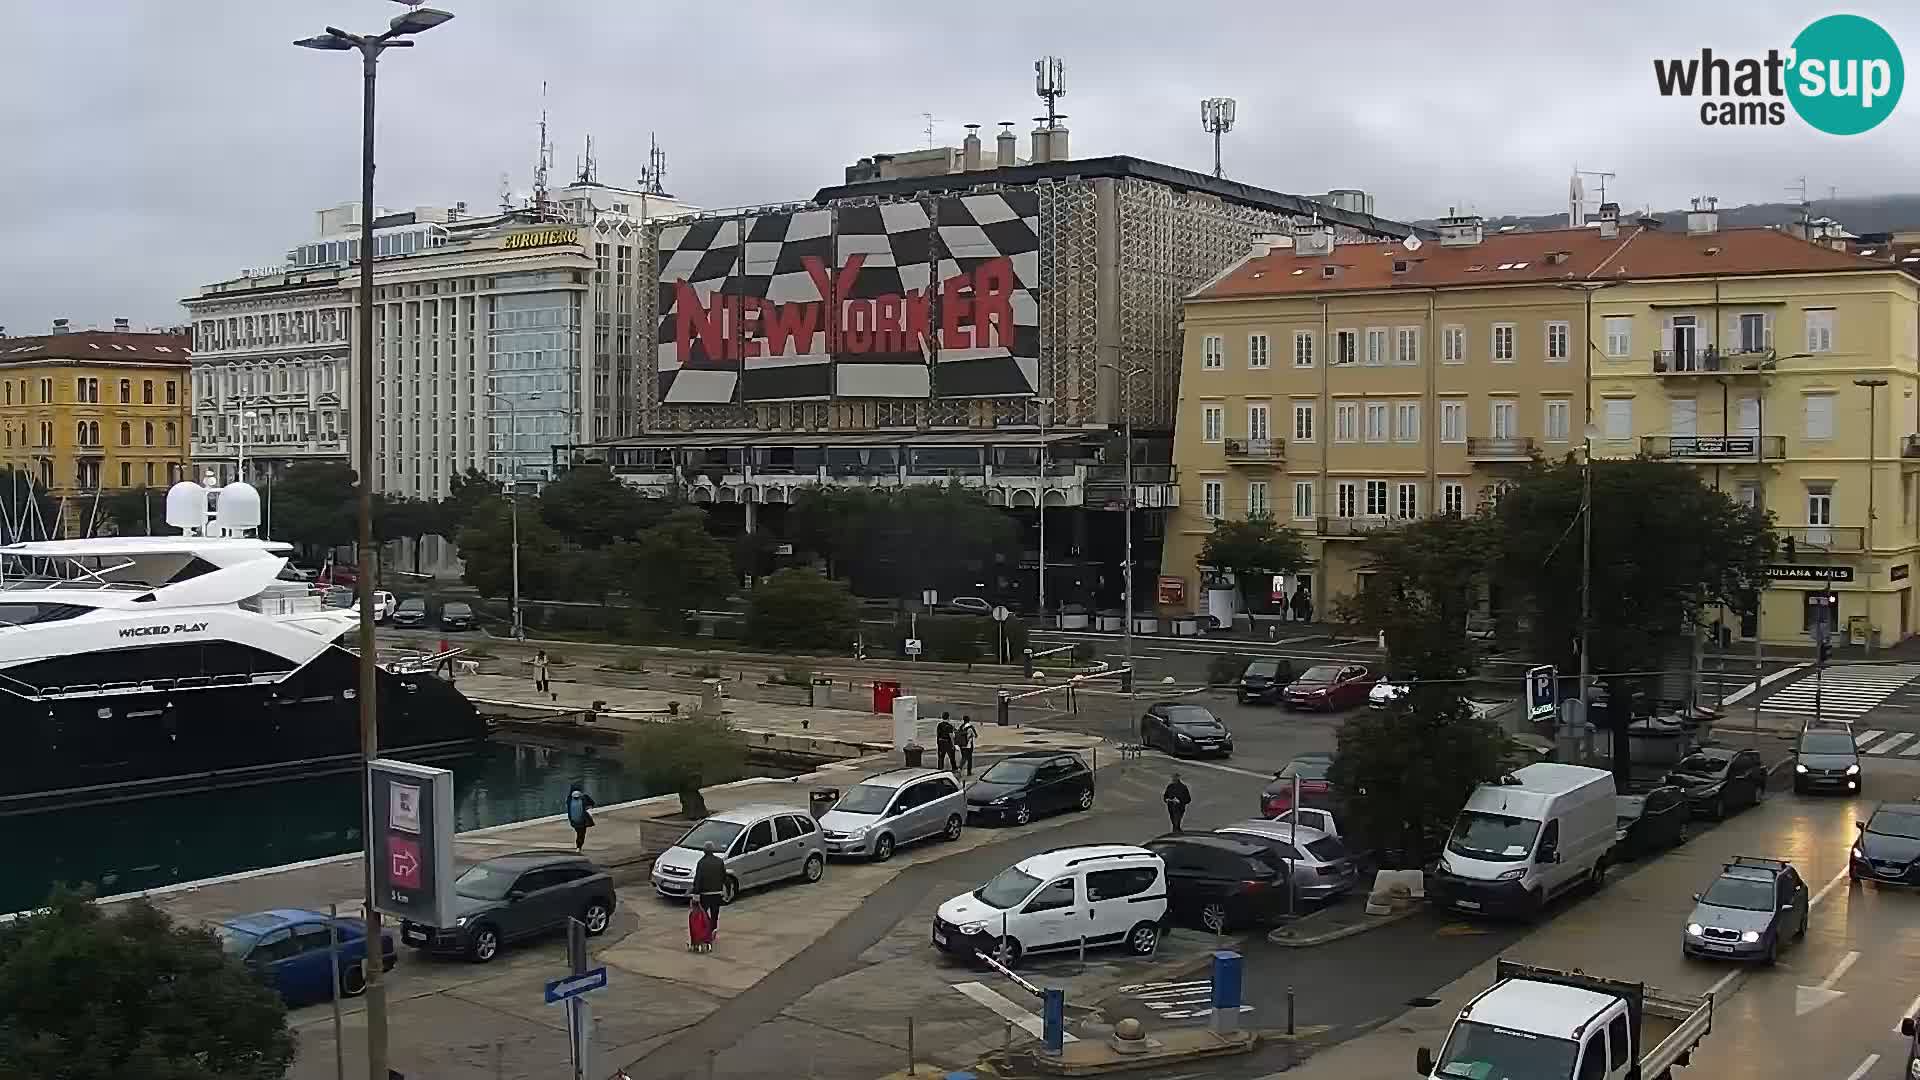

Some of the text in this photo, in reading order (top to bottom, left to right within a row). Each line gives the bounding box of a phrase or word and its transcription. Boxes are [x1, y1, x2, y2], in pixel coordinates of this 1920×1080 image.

[676, 254, 1015, 362] NEW YORKER
[1766, 568, 1848, 578] JULIANA NAILS
[119, 622, 209, 637] WICKED PLAY
[1537, 673, 1549, 697] P
